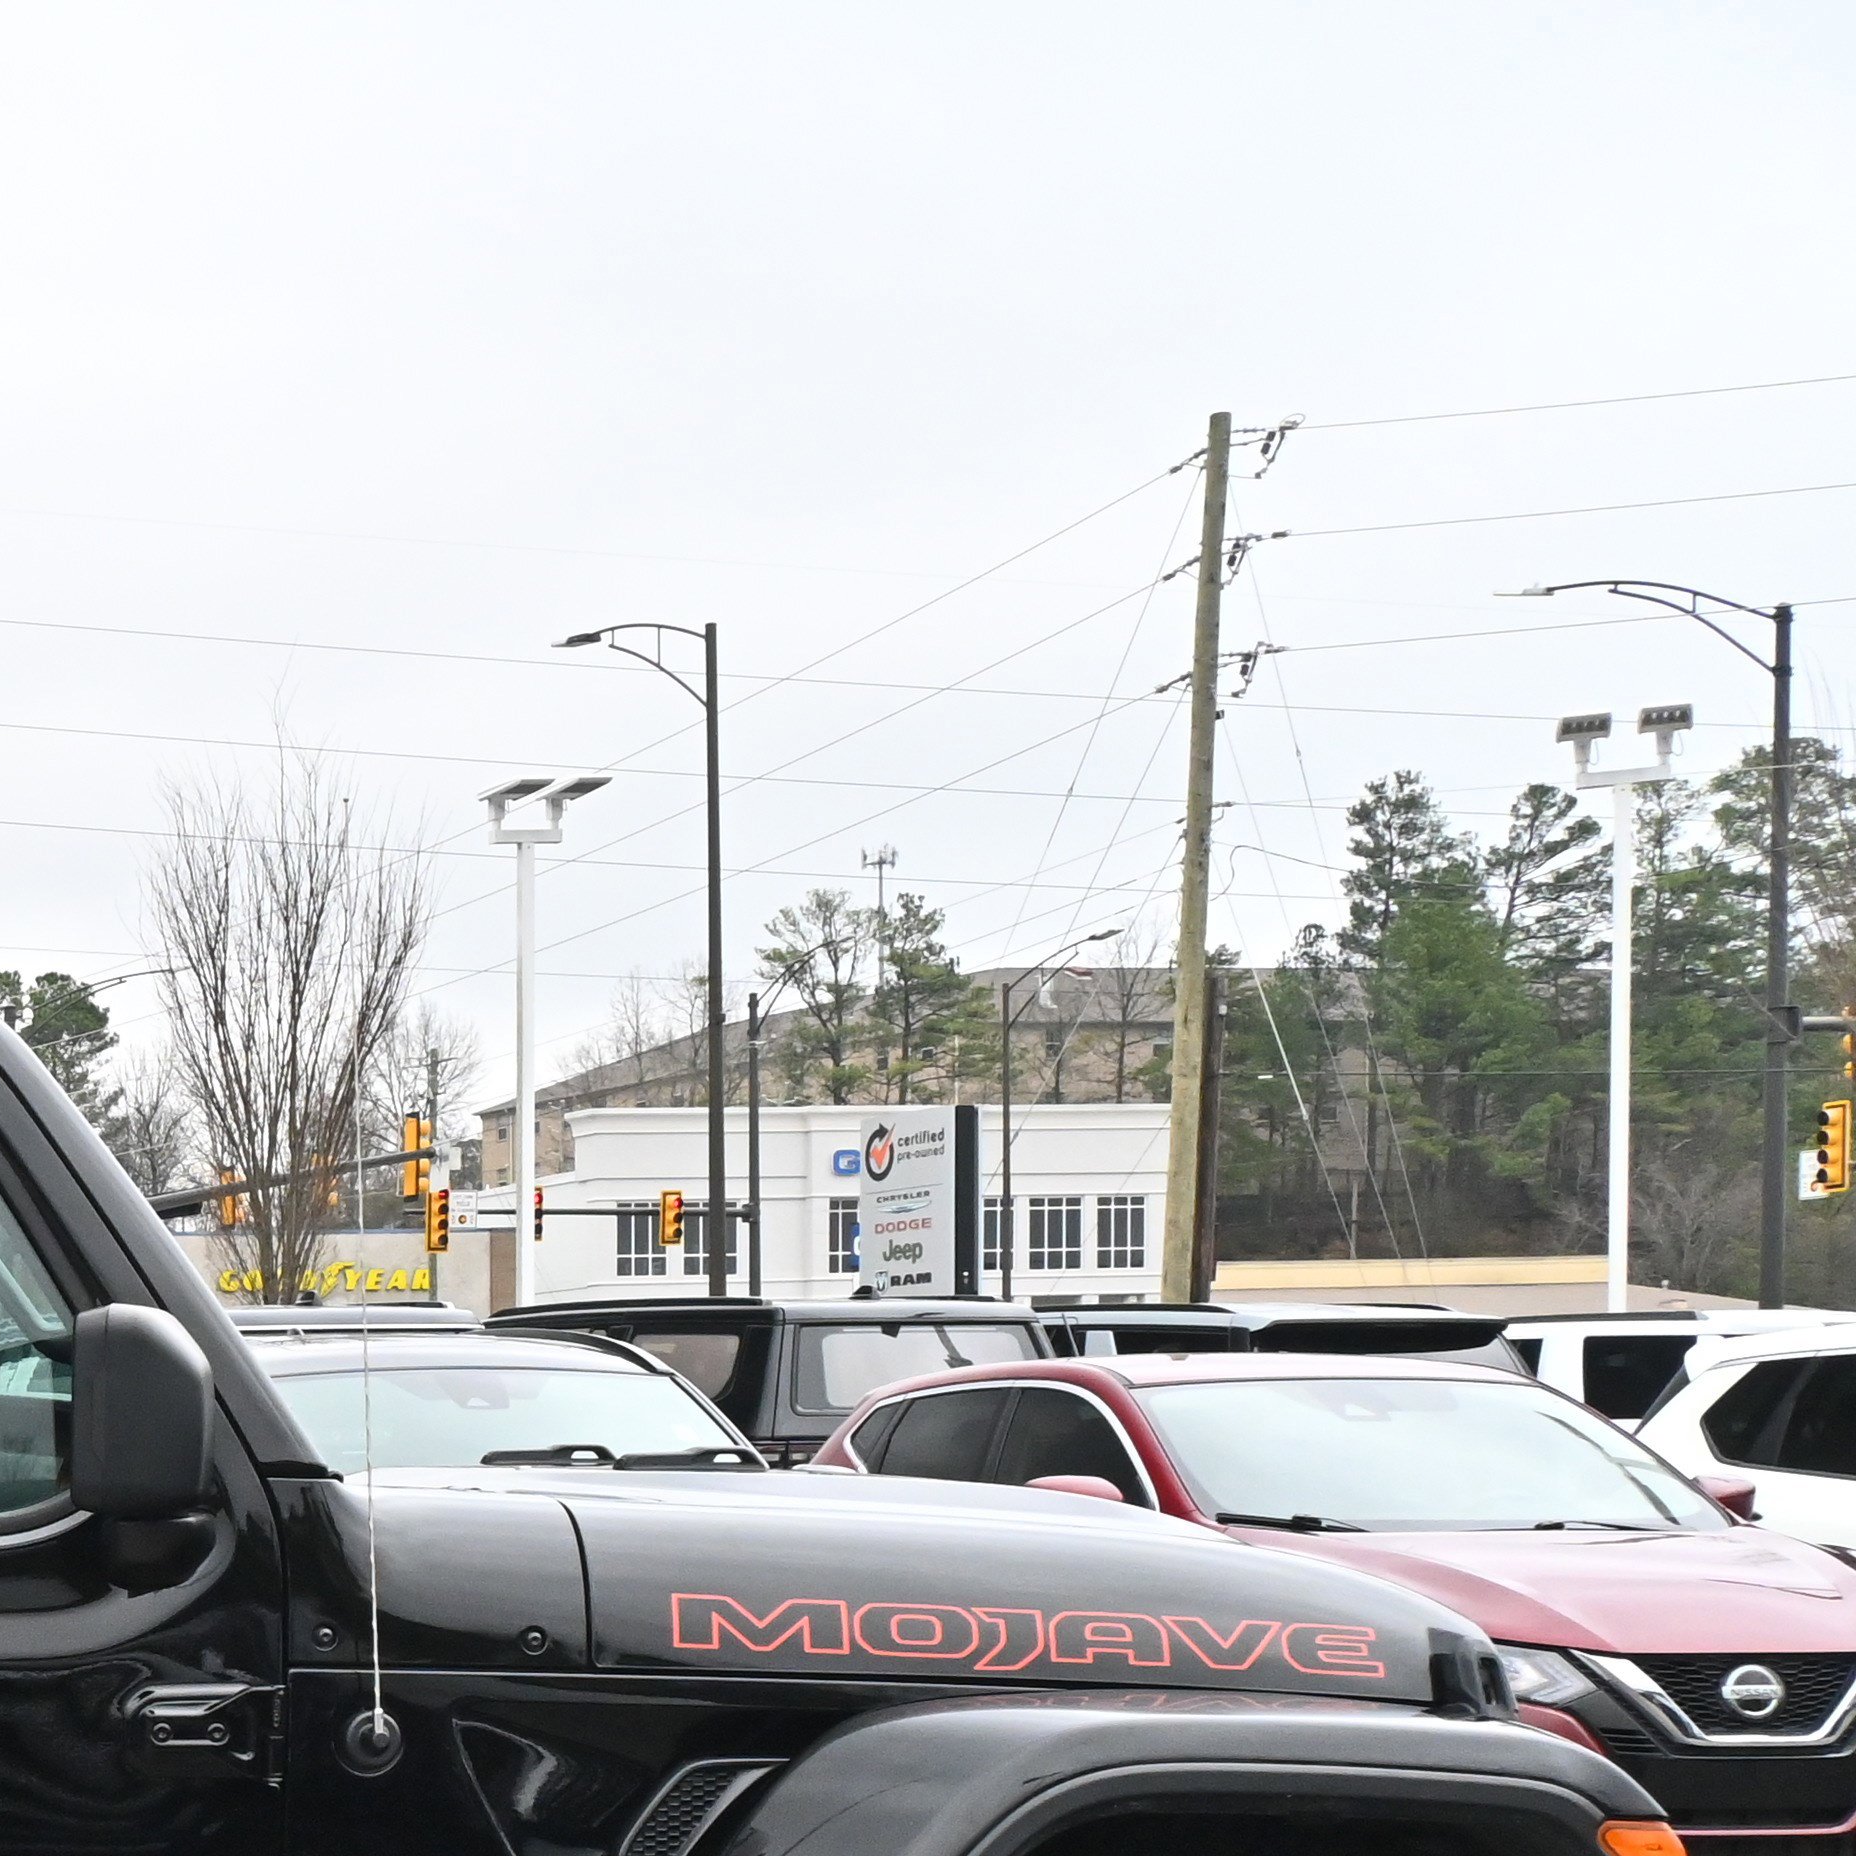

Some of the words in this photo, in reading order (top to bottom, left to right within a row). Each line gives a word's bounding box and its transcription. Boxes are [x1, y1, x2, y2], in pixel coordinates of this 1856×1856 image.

[897, 1127, 945, 1147] certified
[897, 1144, 945, 1164] pre-owned
[876, 1190, 931, 1204] CHRYSLER
[874, 1217, 932, 1234] DODGE
[882, 1239, 923, 1264] Jeep
[218, 1266, 431, 1293] GODYEAR
[890, 1272, 932, 1287] RAM
[671, 1592, 1386, 1679] MOJAVE
